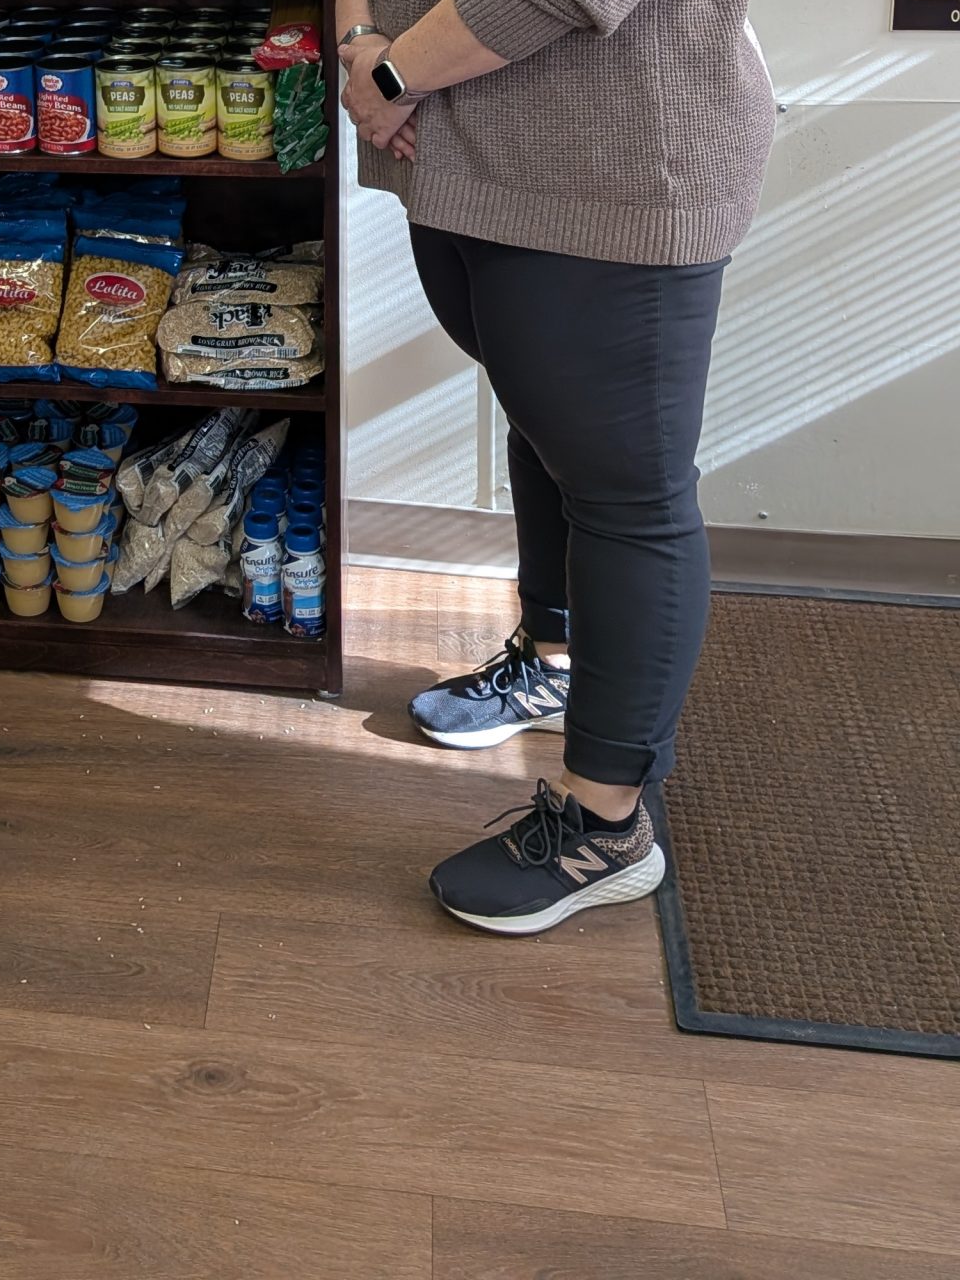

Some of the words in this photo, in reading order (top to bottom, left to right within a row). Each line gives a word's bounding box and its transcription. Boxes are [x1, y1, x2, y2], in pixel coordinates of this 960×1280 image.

[0, 94, 13, 102] Red
[110, 91, 135, 101] PEAS
[170, 90, 194, 100] PEAS
[230, 92, 255, 102] PEAS
[55, 101, 81, 112] Beans
[91, 281, 139, 299] Lolita
[245, 554, 276, 566] Ensure
